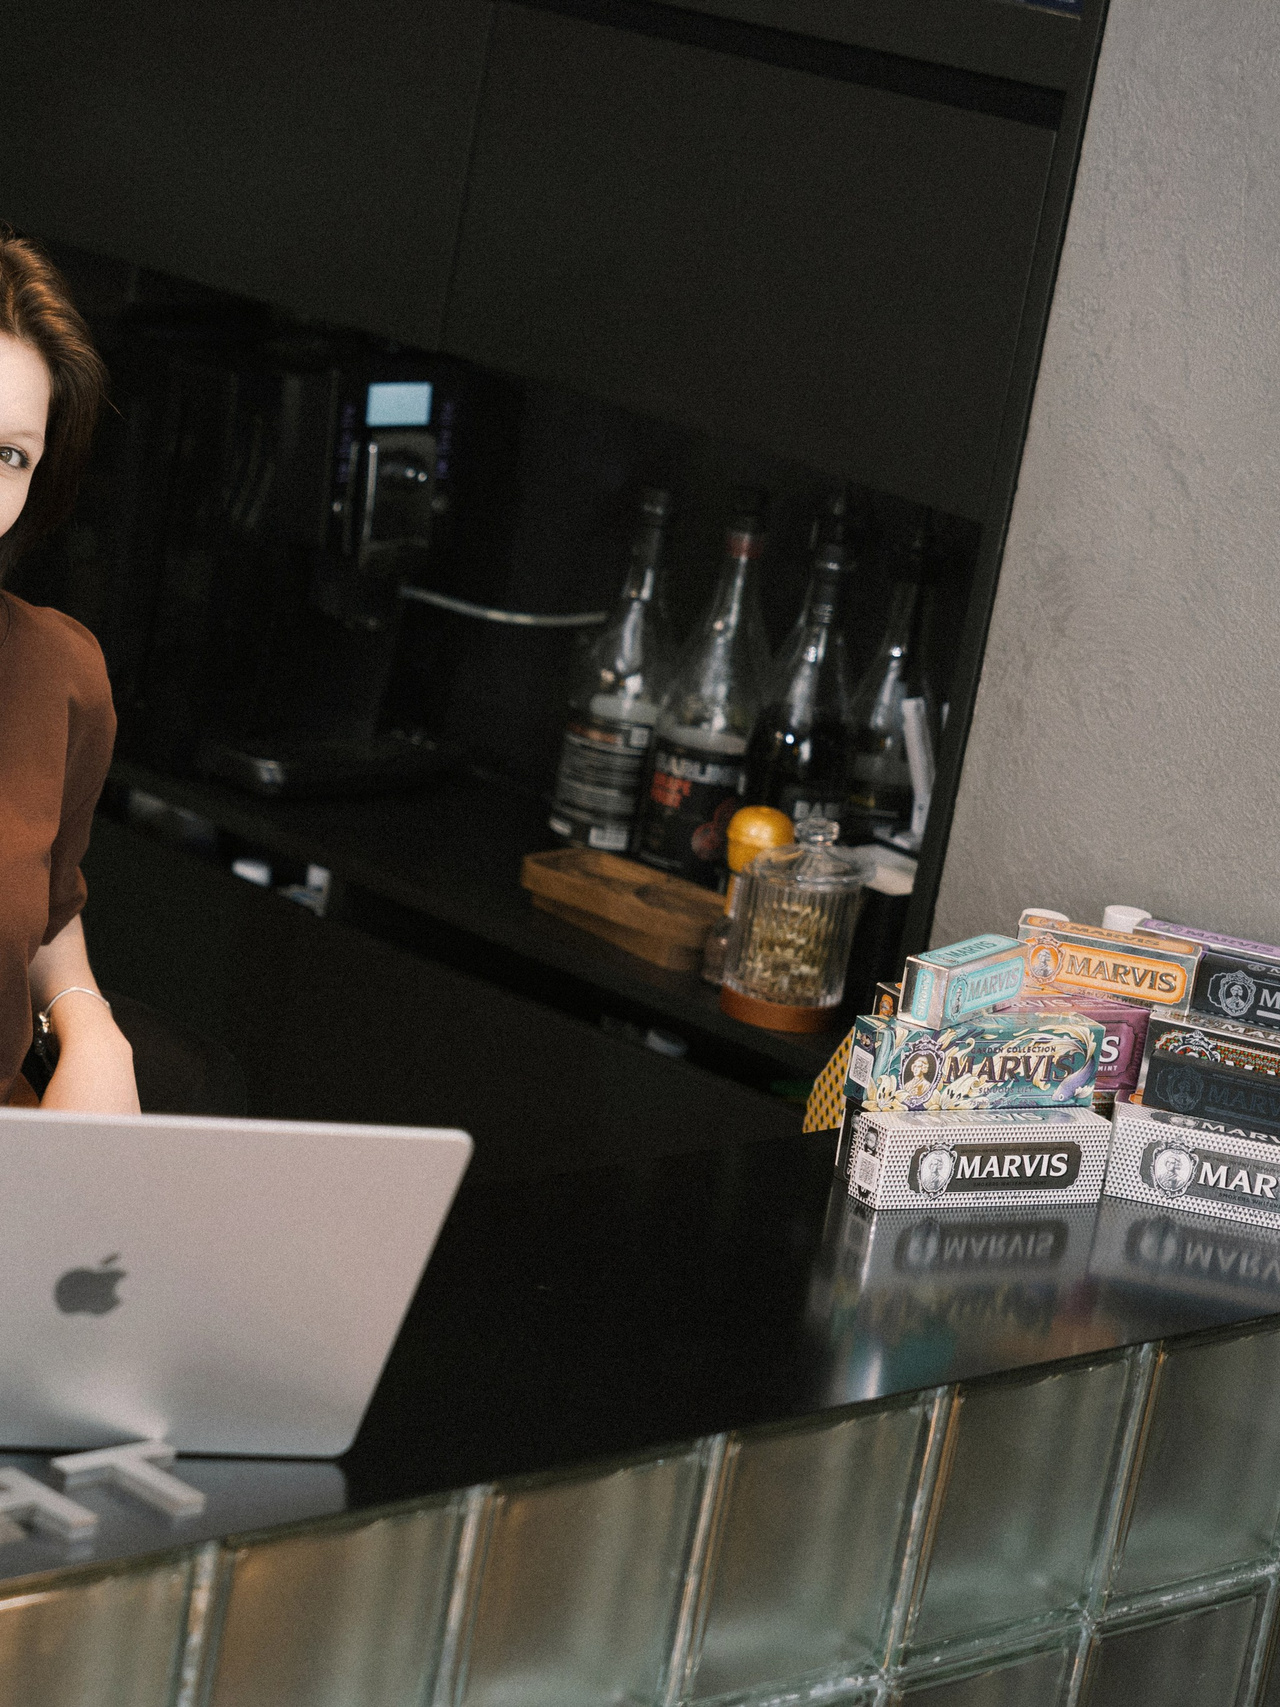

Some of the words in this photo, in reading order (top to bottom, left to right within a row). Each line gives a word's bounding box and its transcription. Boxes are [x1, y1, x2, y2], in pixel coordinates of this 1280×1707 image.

[1069, 925, 1160, 946] MARVIS
[1185, 930, 1274, 953] MARVIS
[944, 940, 998, 958] MARVIS
[967, 967, 1020, 1002] MARVIS
[1066, 954, 1178, 994] MARVIS
[943, 1054, 1076, 1083] MARVIS
[944, 1112, 1043, 1122] MARVIS
[846, 1131, 859, 1176] MARVIS
[956, 1153, 1069, 1179] MARVIS
[1197, 1161, 1280, 1199] MAR
[1252, 1199, 1280, 1209] WHITEN
